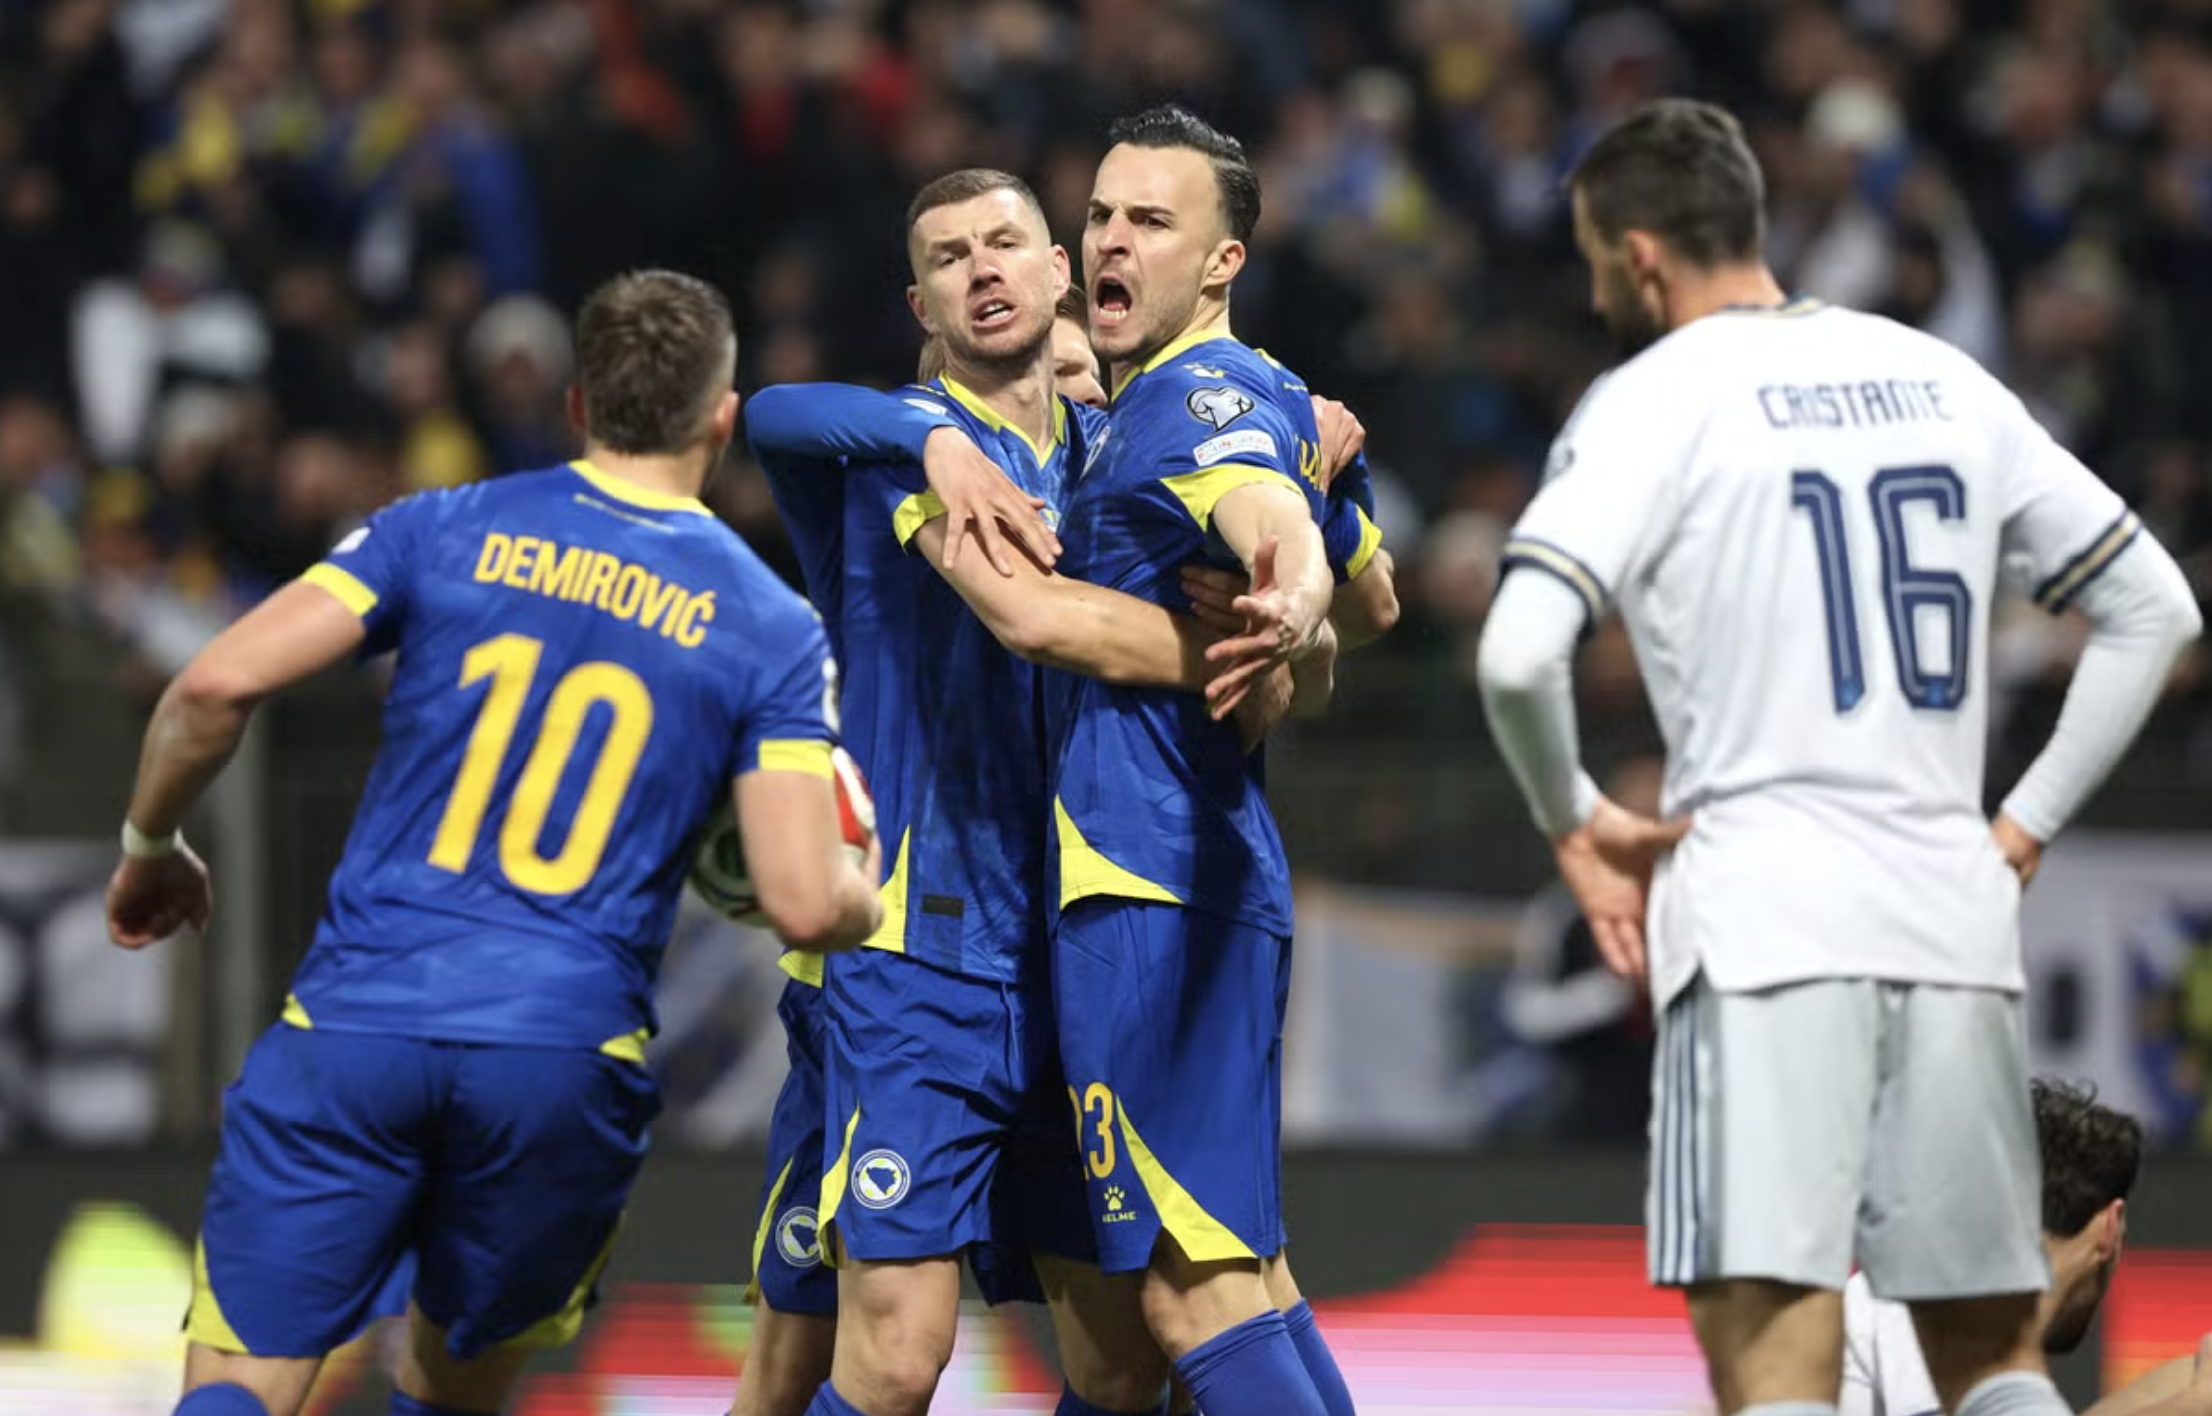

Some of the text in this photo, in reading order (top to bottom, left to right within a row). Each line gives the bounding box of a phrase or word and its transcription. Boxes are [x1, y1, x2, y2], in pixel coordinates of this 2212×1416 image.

[1755, 377, 1955, 431] CRISTANTE
[474, 532, 716, 647] DEMIROVIĆ
[1791, 464, 1973, 714] 16
[427, 632, 654, 895] 10
